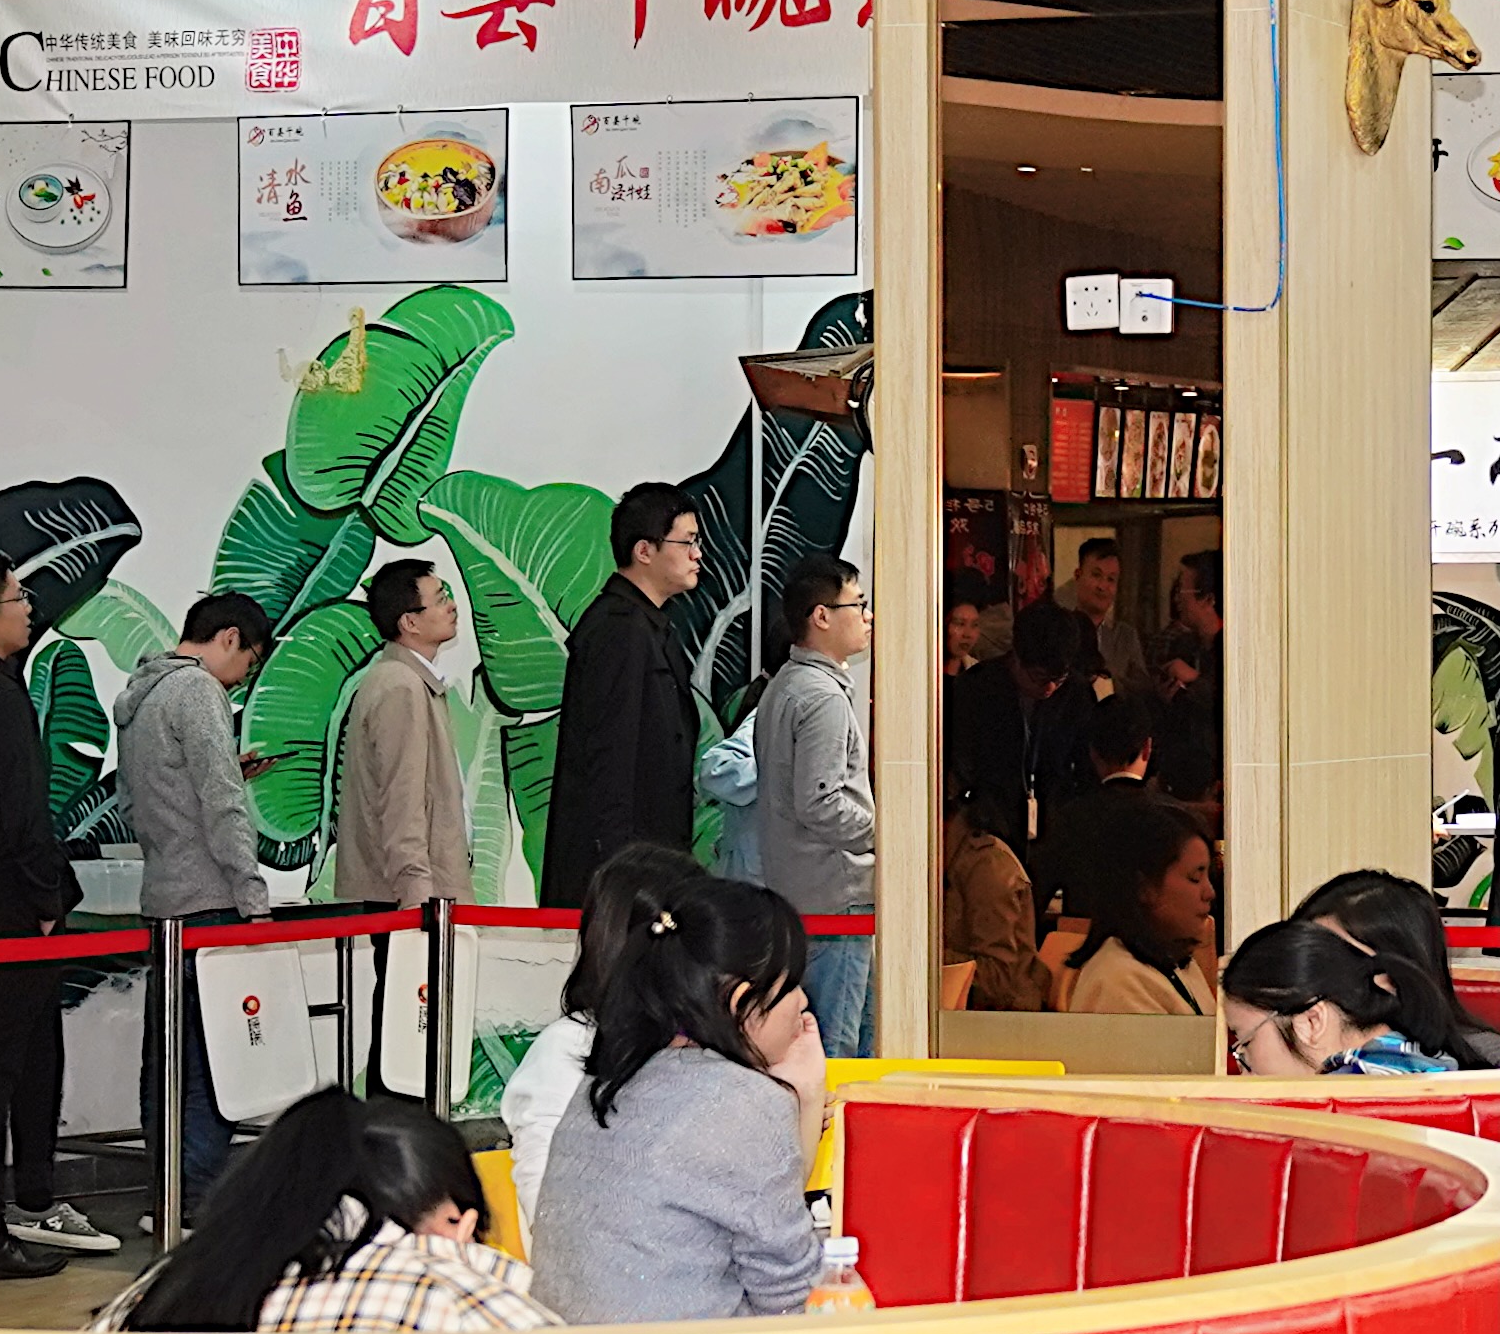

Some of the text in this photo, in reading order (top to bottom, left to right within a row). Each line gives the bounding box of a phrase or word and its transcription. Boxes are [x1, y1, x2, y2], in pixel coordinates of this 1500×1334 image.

[45, 28, 246, 52] 中华传统美食 美味回味无穷
[0, 31, 215, 92] CHINESE FOOD
